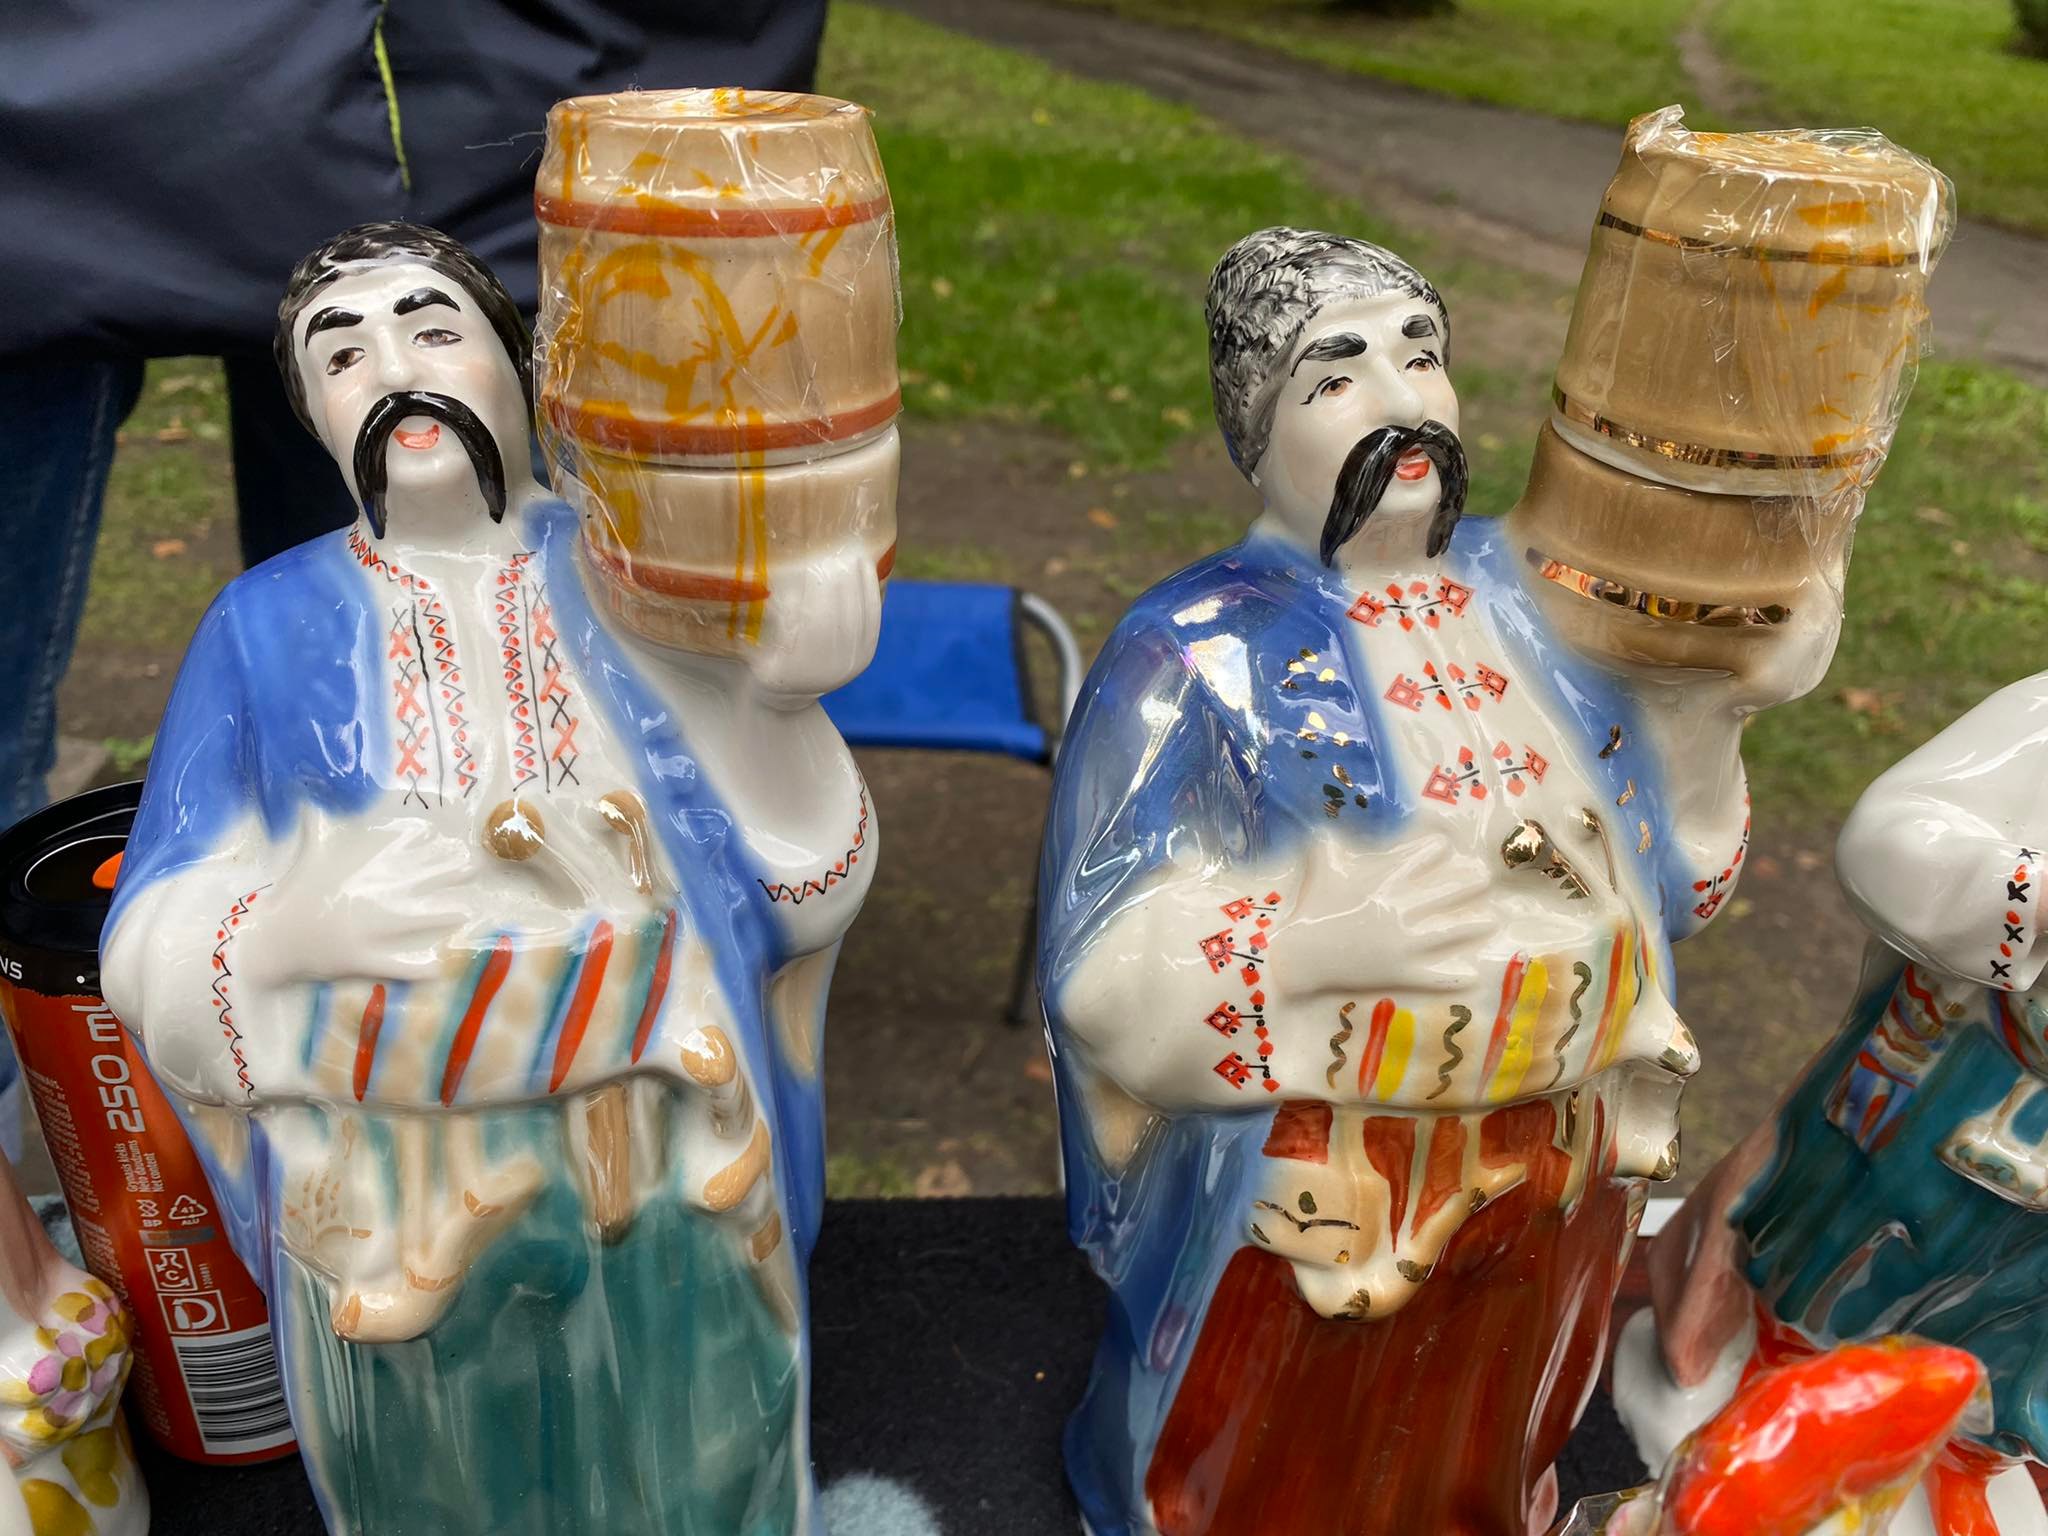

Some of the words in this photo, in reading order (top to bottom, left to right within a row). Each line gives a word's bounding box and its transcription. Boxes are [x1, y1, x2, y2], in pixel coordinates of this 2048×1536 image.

[71, 1001, 121, 1042] ml
[91, 1054, 146, 1133] 250
[115, 1143, 129, 1163] kiekis
[128, 1140, 147, 1176] daudzums
[143, 1152, 161, 1179] content
[122, 1163, 138, 1192] Grynasis
[138, 1176, 153, 1193] Neto
[151, 1180, 165, 1193] Net
